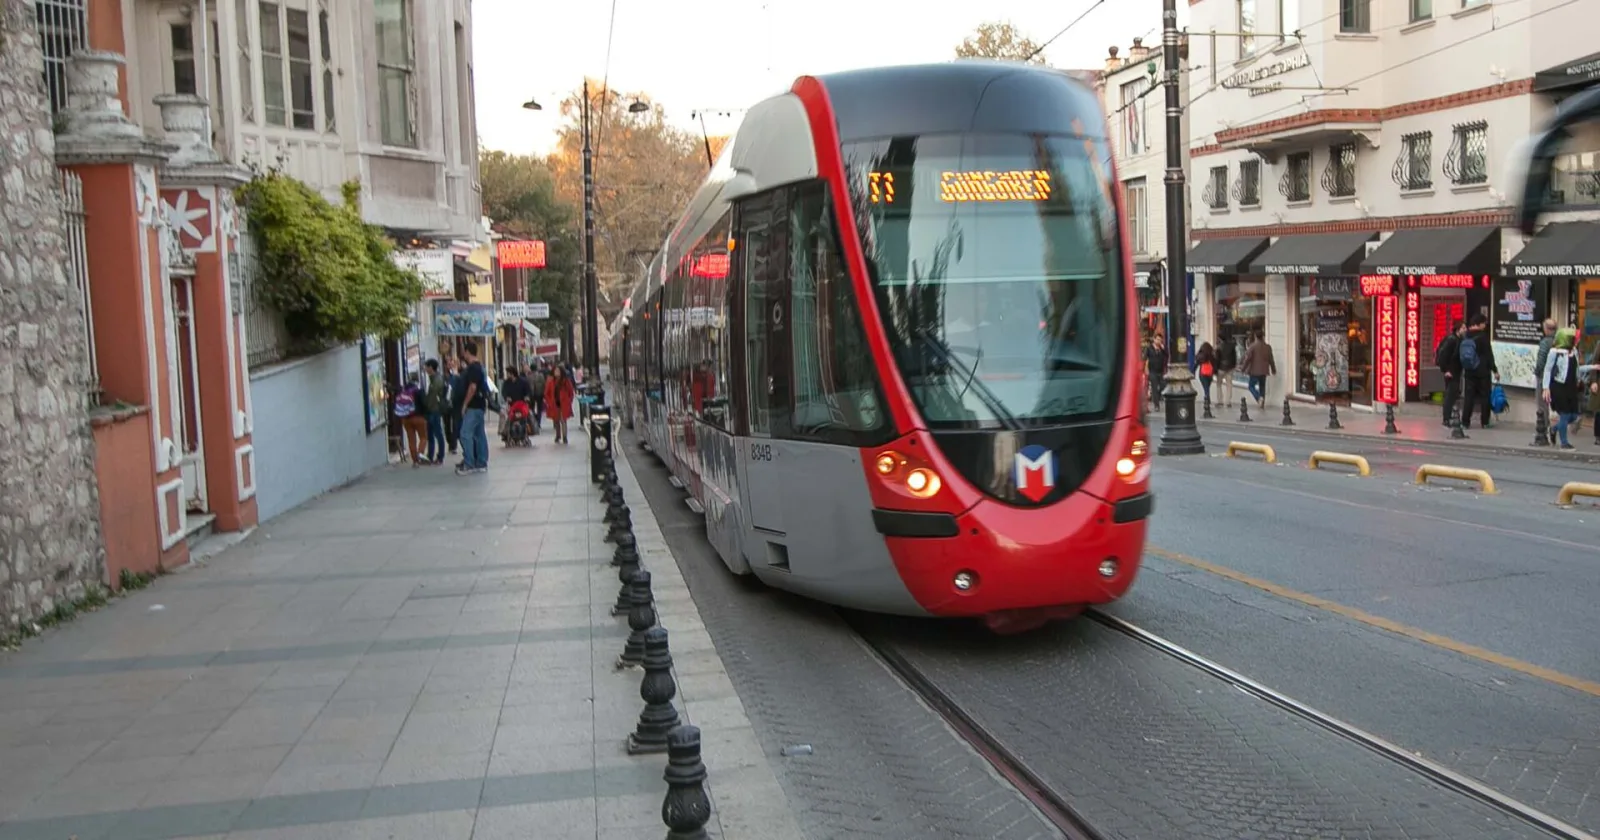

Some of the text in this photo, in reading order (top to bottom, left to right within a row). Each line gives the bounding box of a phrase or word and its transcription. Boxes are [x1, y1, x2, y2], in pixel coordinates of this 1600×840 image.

[869, 171, 894, 203] T1
[1295, 265, 1299, 273] &
[1299, 265, 1319, 274] CERAMIC
[1376, 266, 1400, 275] CHANGE
[1404, 266, 1436, 275] EXCHANGE
[1515, 265, 1537, 275] ROAD
[1539, 265, 1572, 276] RUNNER
[1361, 275, 1392, 285] CHANGE
[1422, 275, 1473, 287] CHANGE OFFICE
[1364, 285, 1391, 295] OFFICE
[1407, 292, 1417, 386] NO COMMISSION
[1382, 297, 1392, 400] EXCHANGE
[751, 443, 772, 462] 834B
